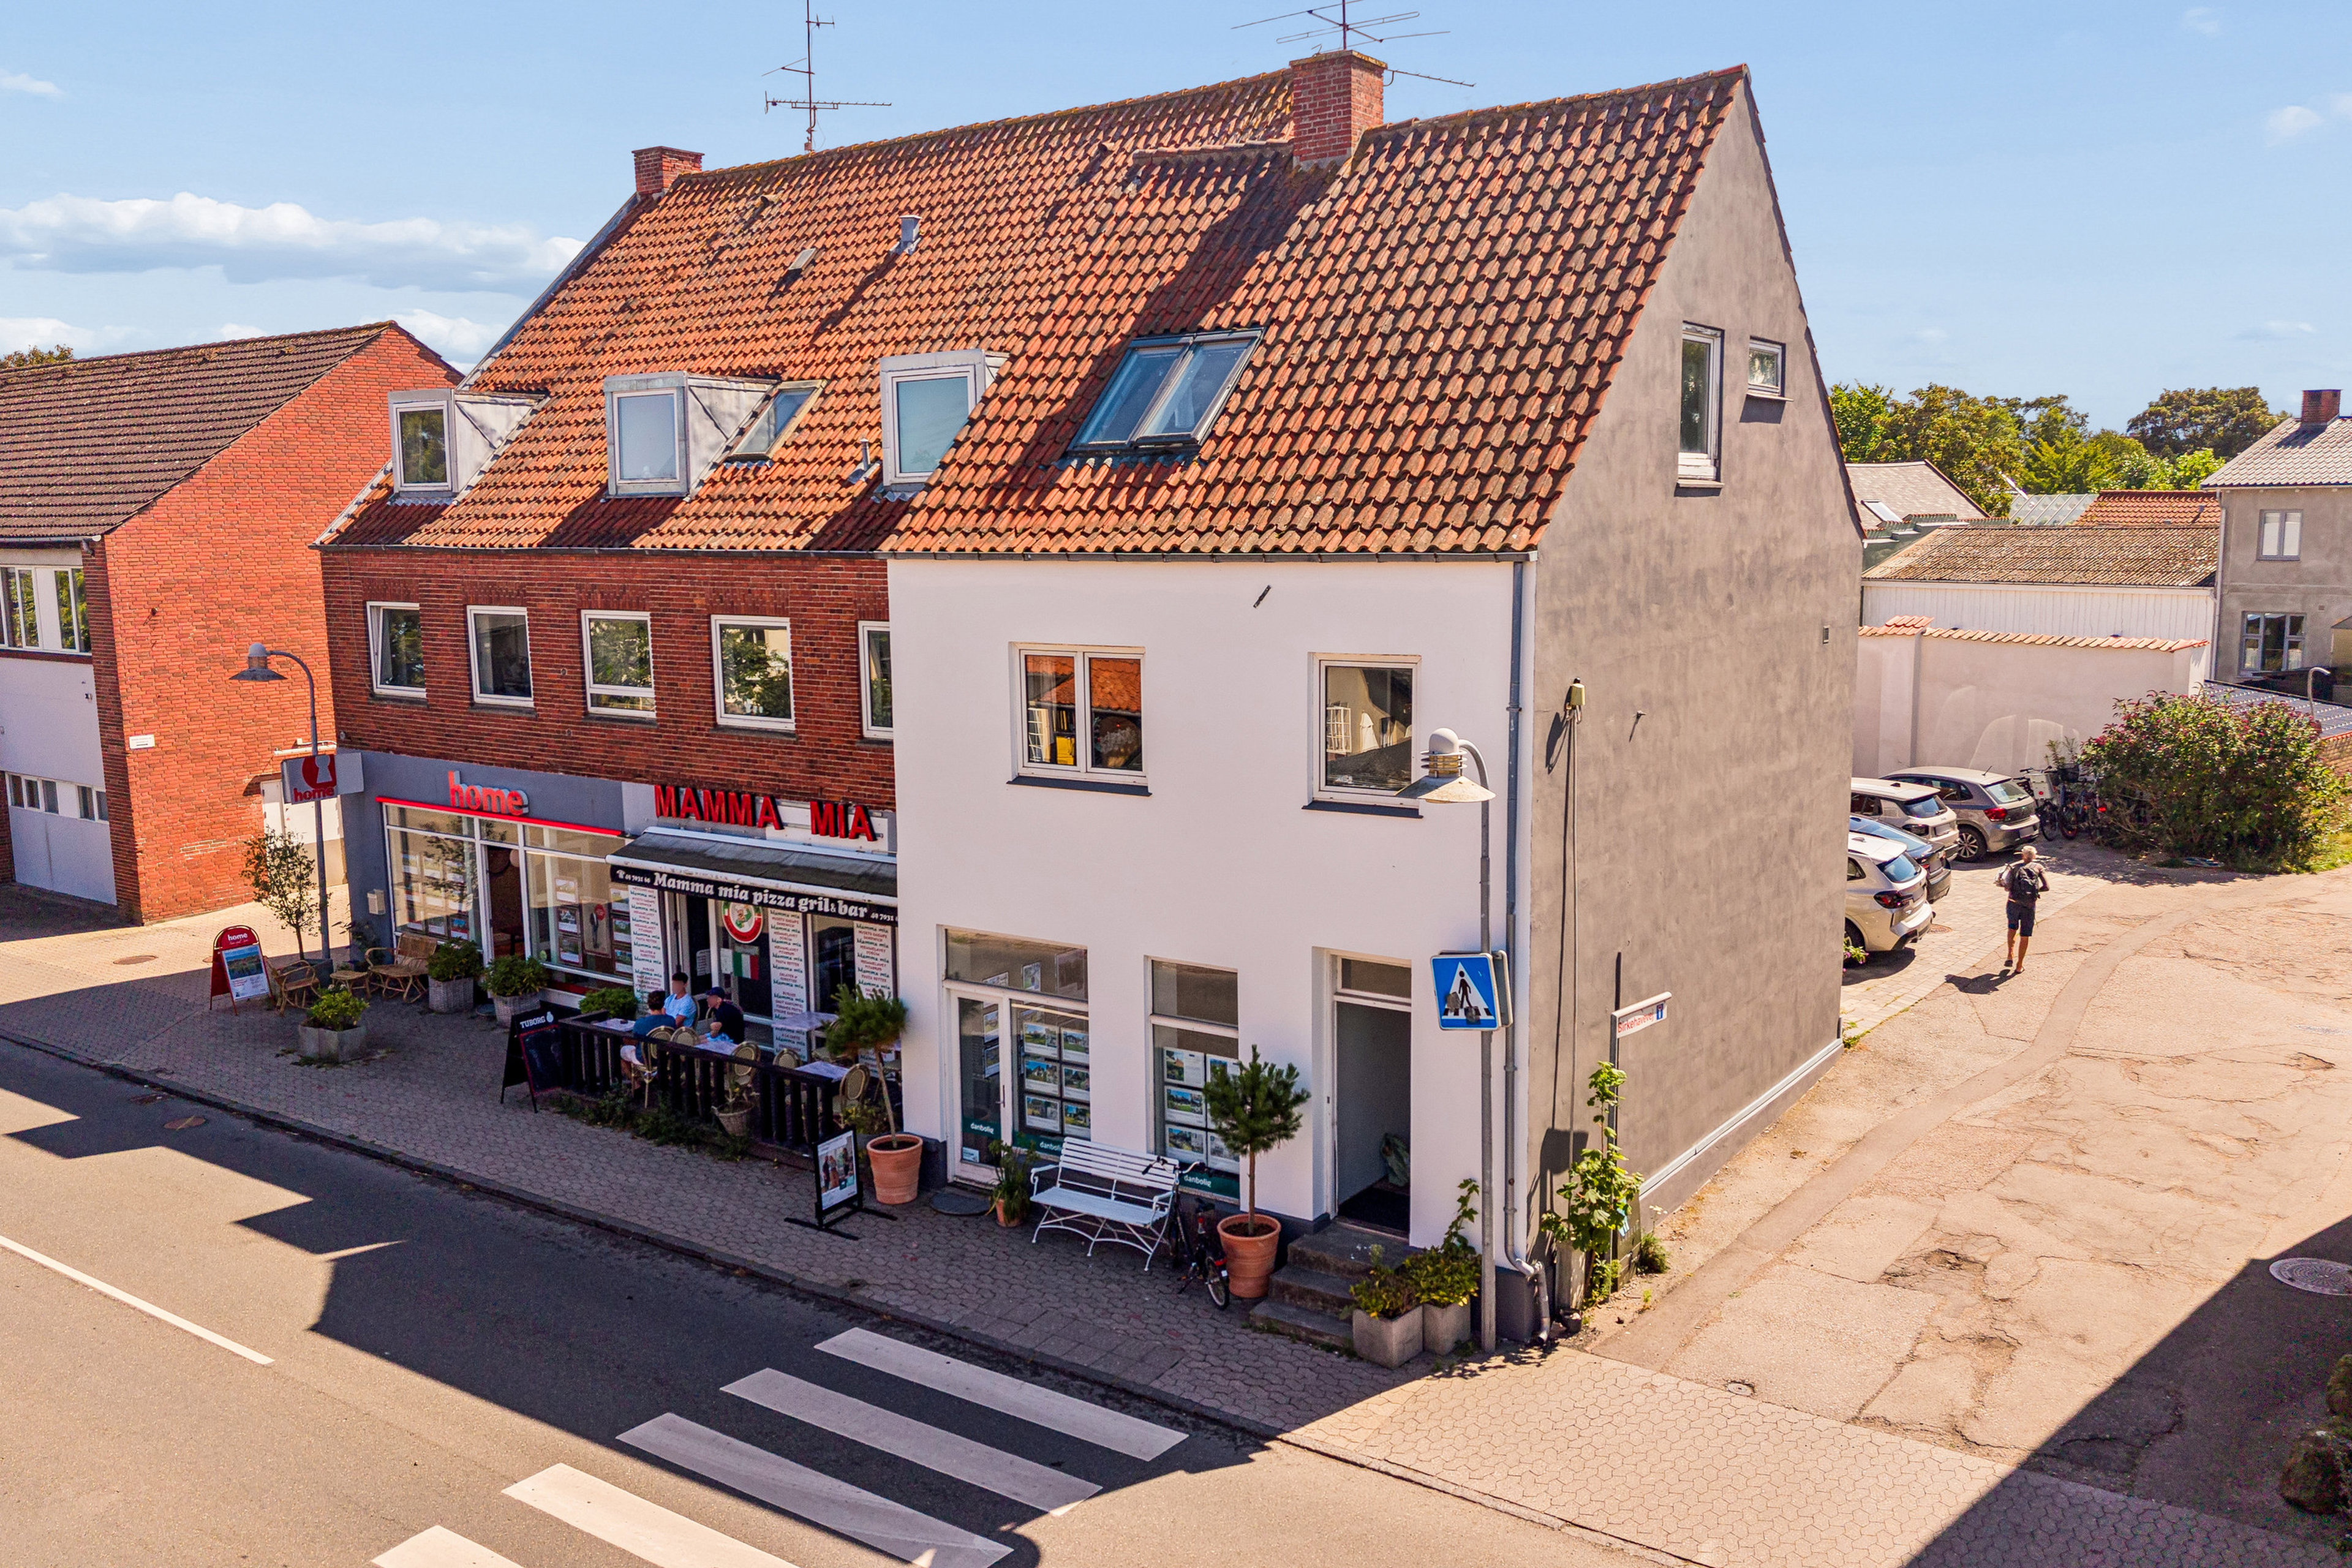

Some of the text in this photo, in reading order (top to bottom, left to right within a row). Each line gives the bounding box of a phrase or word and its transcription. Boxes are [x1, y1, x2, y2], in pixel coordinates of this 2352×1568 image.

[293, 788, 334, 802] home
[448, 771, 526, 816] home
[654, 785, 876, 842] MAMMA MIA
[654, 872, 714, 895] Mamma
[718, 884, 749, 900] mia
[752, 889, 796, 908] pizza
[519, 1016, 546, 1028] TUBORG
[1618, 1012, 1654, 1033] Birkehavevej
[1184, 1175, 1212, 1188] danbolig
